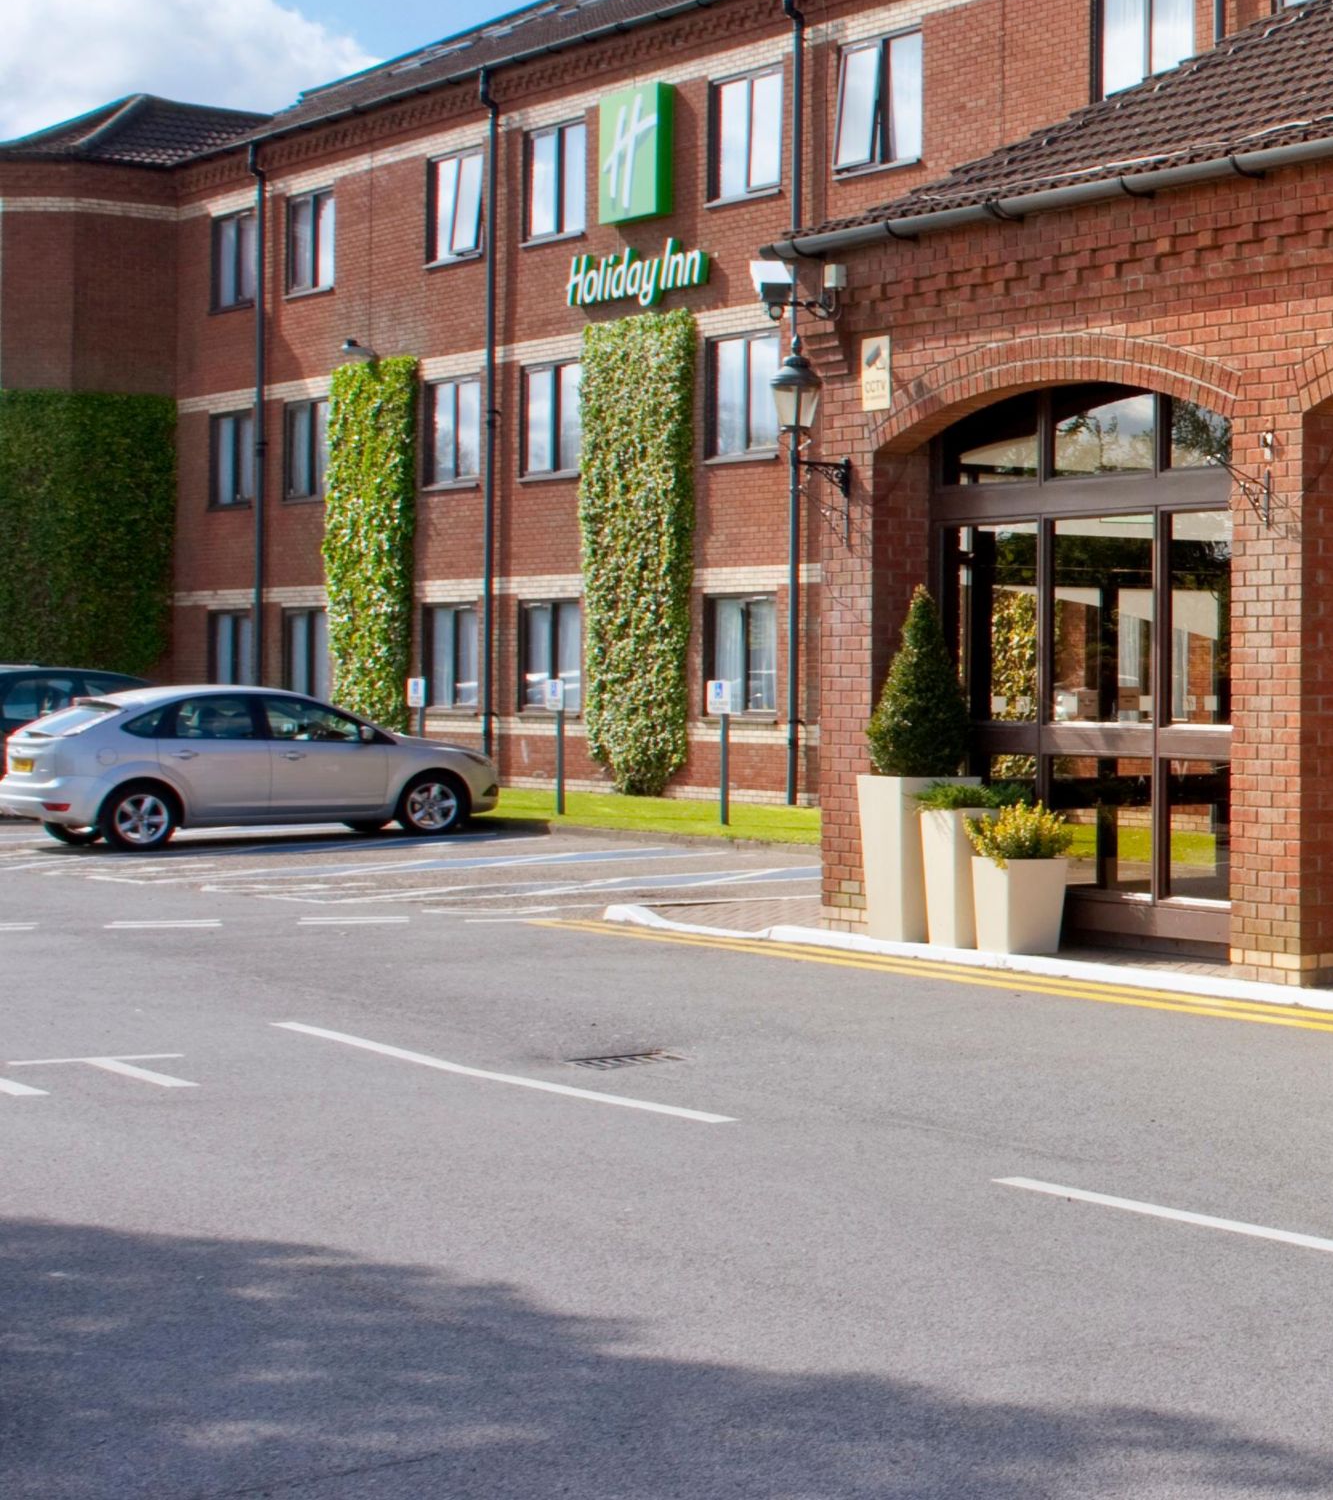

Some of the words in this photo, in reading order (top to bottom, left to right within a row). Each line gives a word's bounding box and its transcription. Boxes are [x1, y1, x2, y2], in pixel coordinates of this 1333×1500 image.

[566, 246, 661, 307] Holiday
[660, 237, 703, 291] Inn
[865, 379, 886, 394] CCTV
